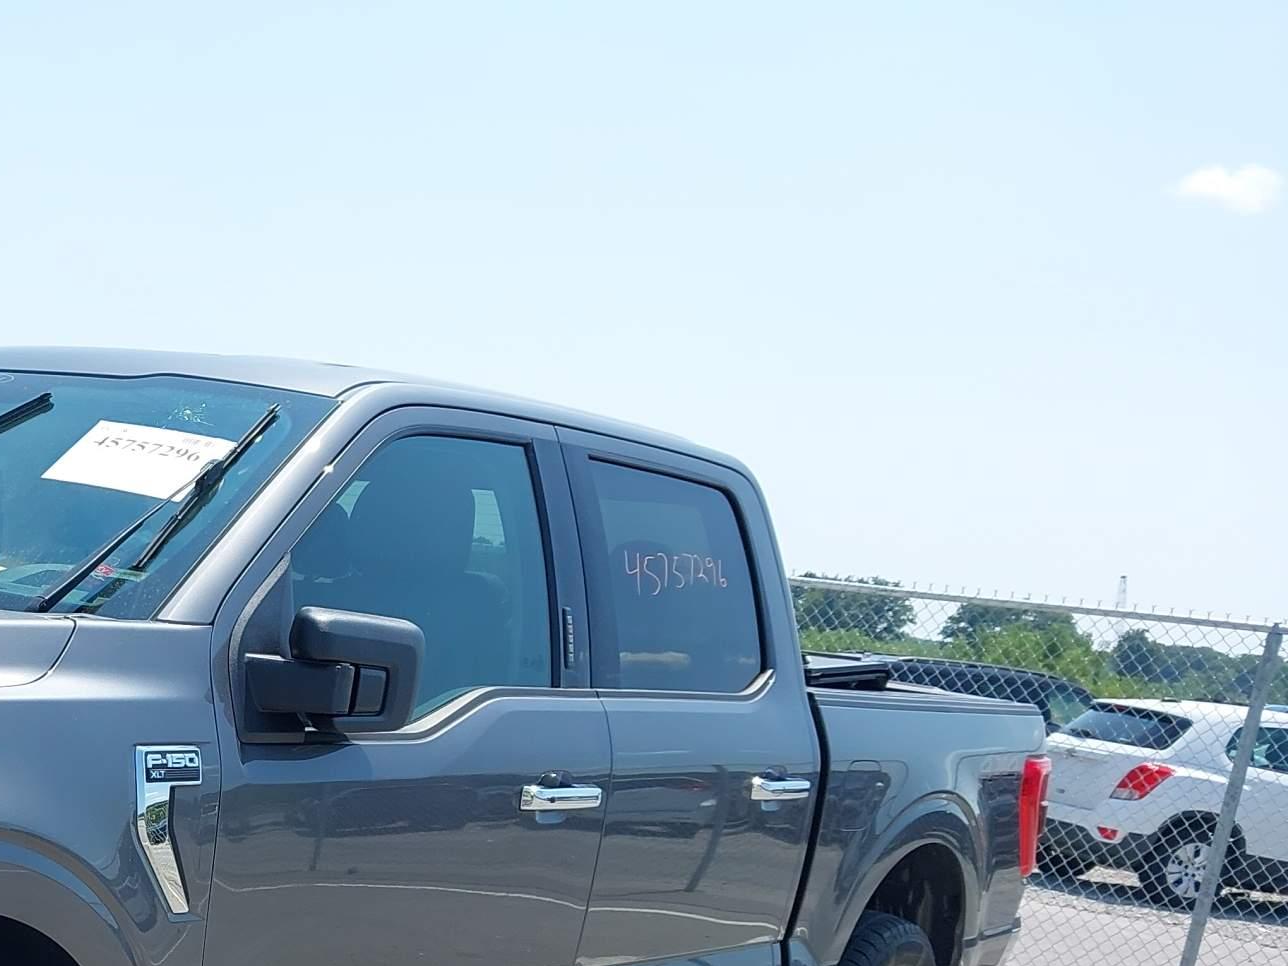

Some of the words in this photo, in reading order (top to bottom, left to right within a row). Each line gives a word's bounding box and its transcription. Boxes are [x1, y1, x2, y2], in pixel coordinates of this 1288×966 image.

[94, 436, 200, 462] 45757296
[624, 550, 728, 595] 45757296
[146, 752, 199, 768] F-150
[150, 770, 165, 779] XLT
